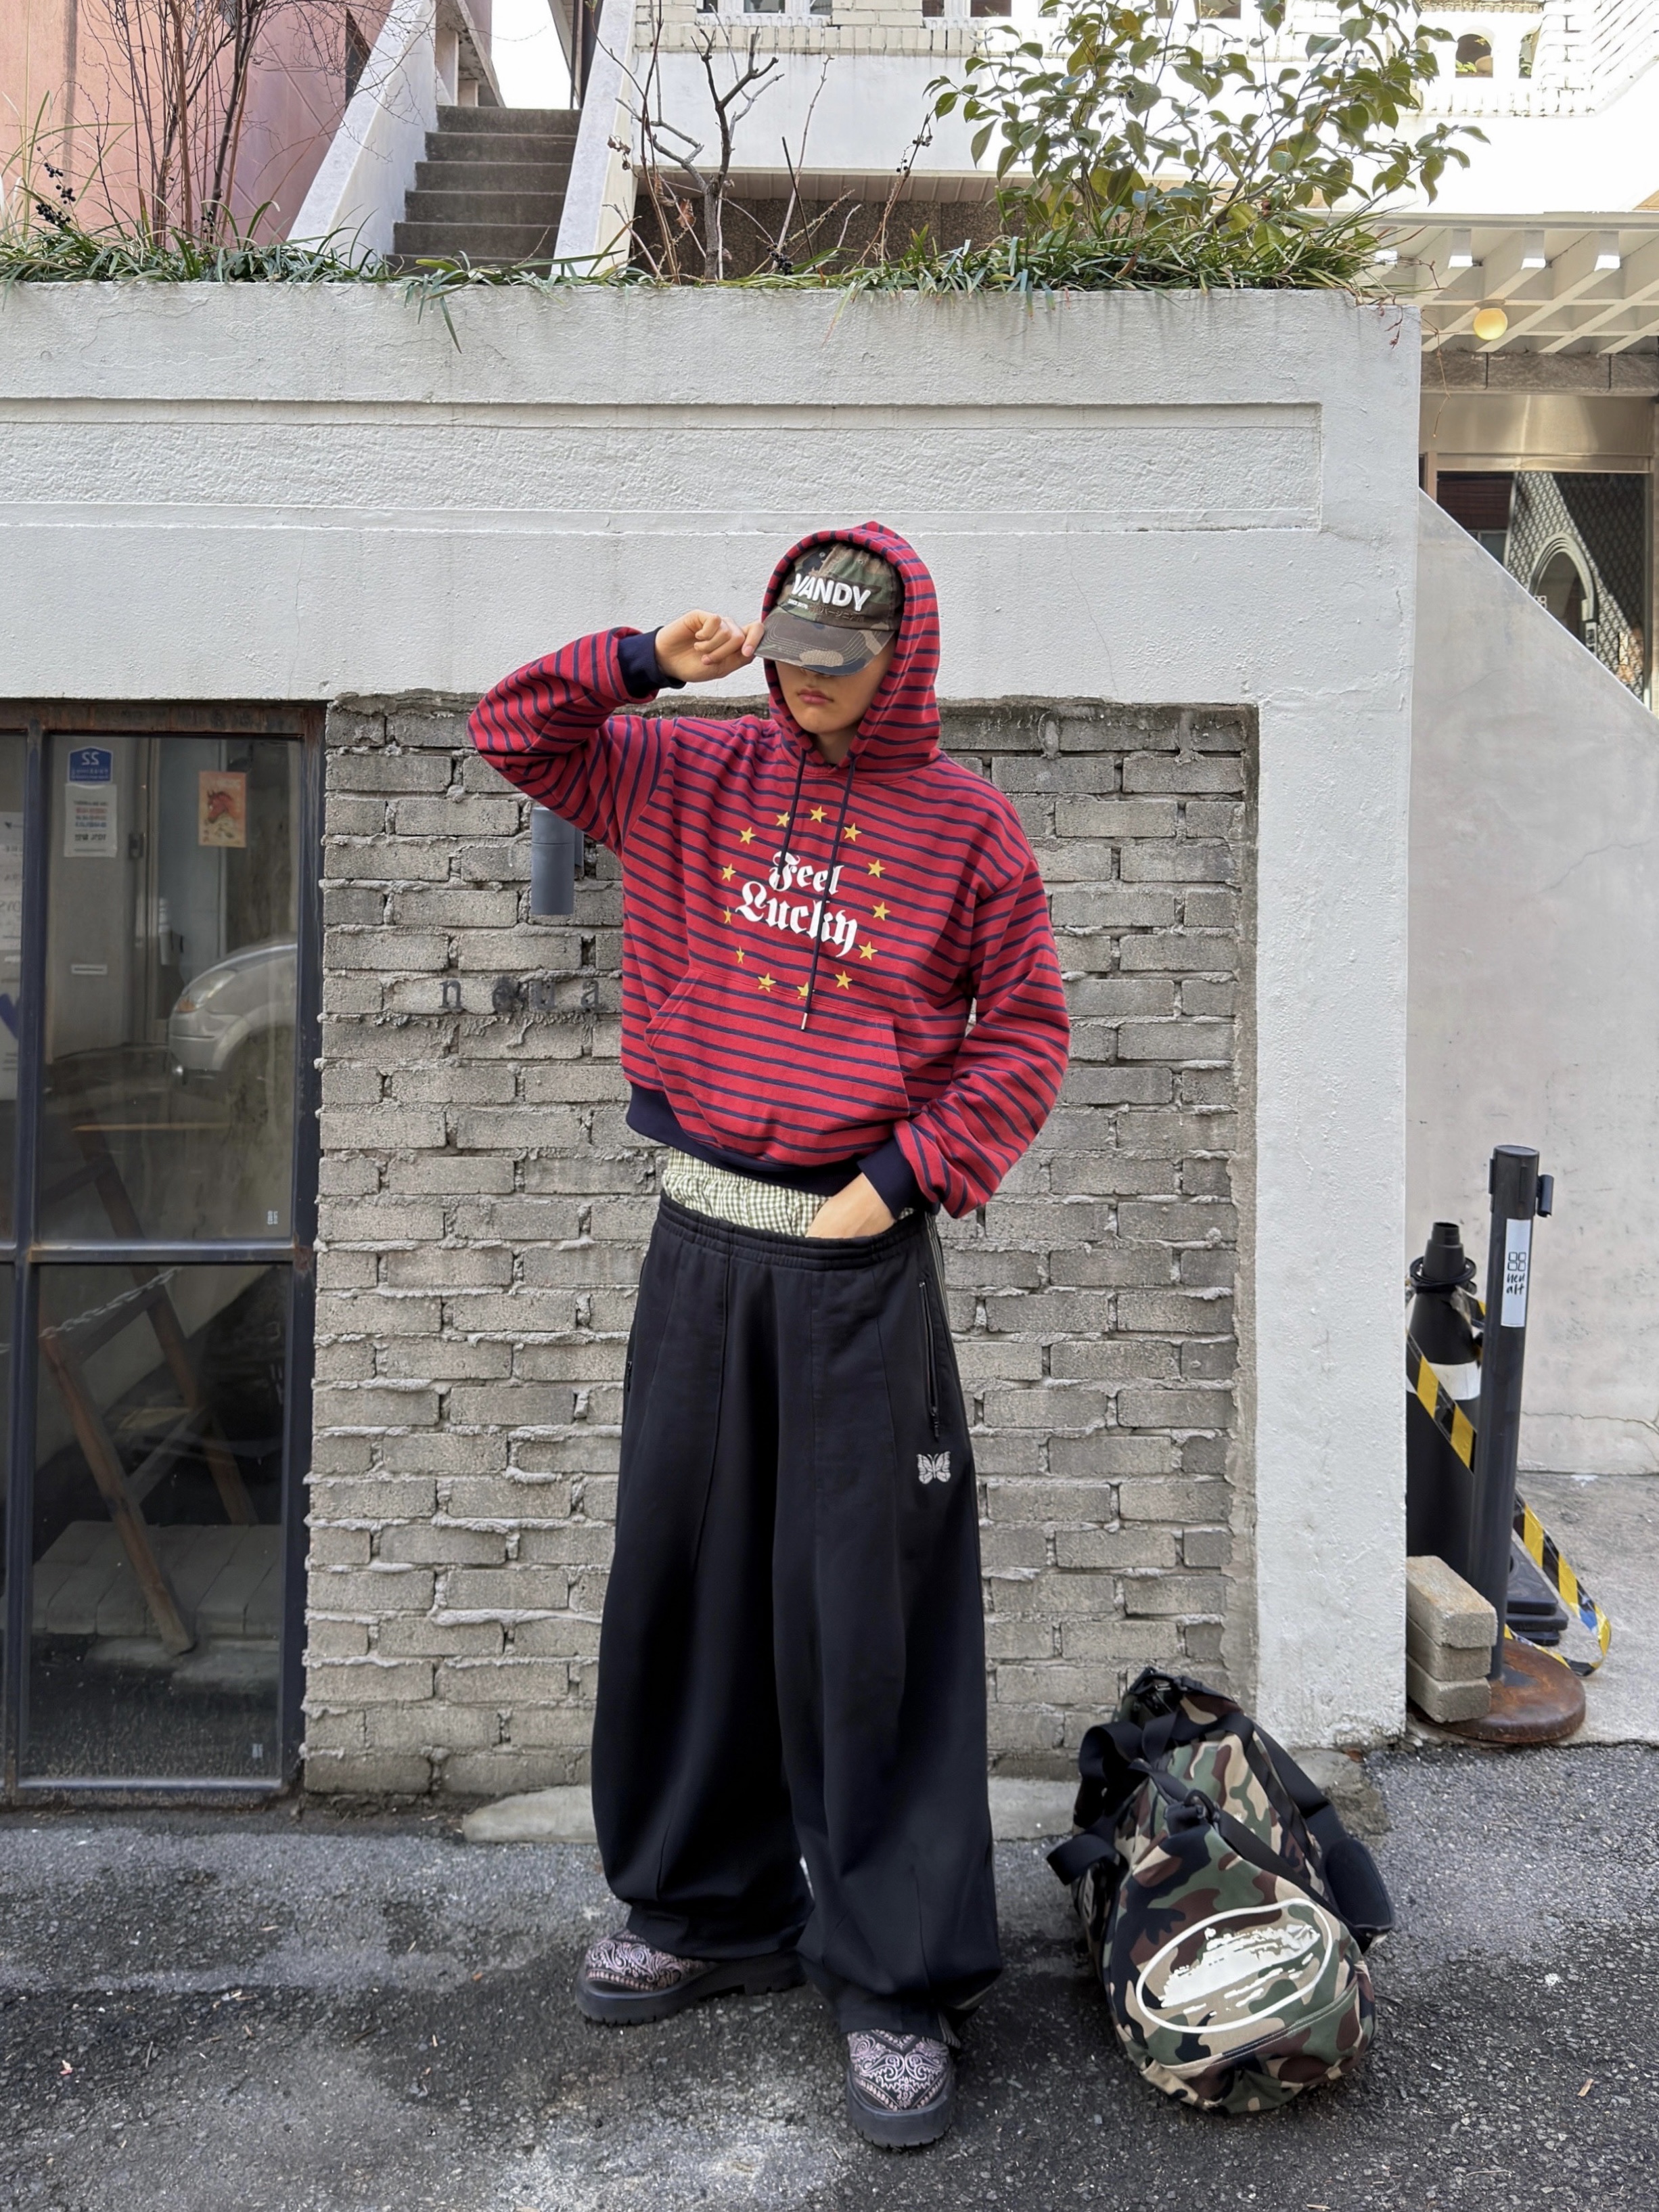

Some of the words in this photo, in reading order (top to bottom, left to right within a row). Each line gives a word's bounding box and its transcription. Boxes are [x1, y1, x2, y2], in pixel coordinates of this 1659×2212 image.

[791, 573, 871, 612] VANDY
[769, 851, 844, 895] Feel
[735, 881, 858, 957] Lucky
[1506, 1283, 1524, 1295] alt
